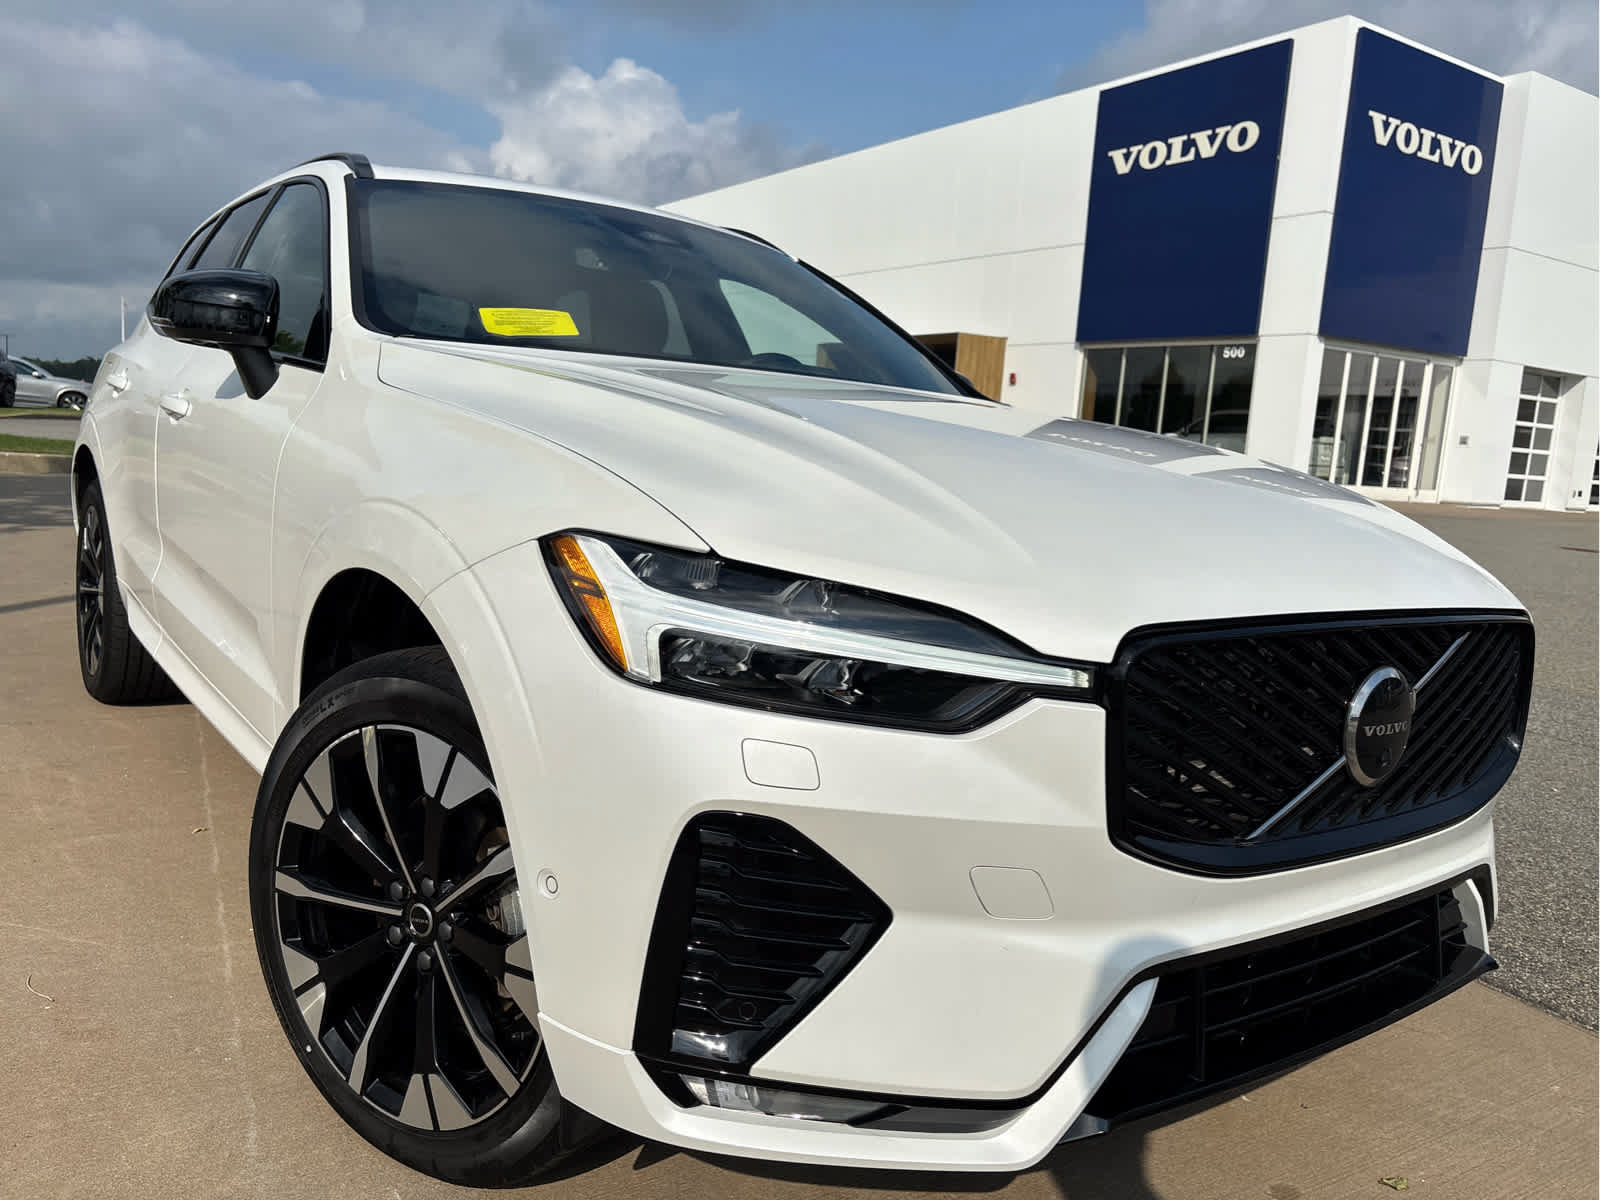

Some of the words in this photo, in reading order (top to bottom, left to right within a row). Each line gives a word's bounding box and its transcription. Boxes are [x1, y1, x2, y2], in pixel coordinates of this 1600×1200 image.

[1108, 121, 1260, 175] VOLVO
[1368, 110, 1483, 175] VOLVO
[1222, 345, 1245, 358] 500
